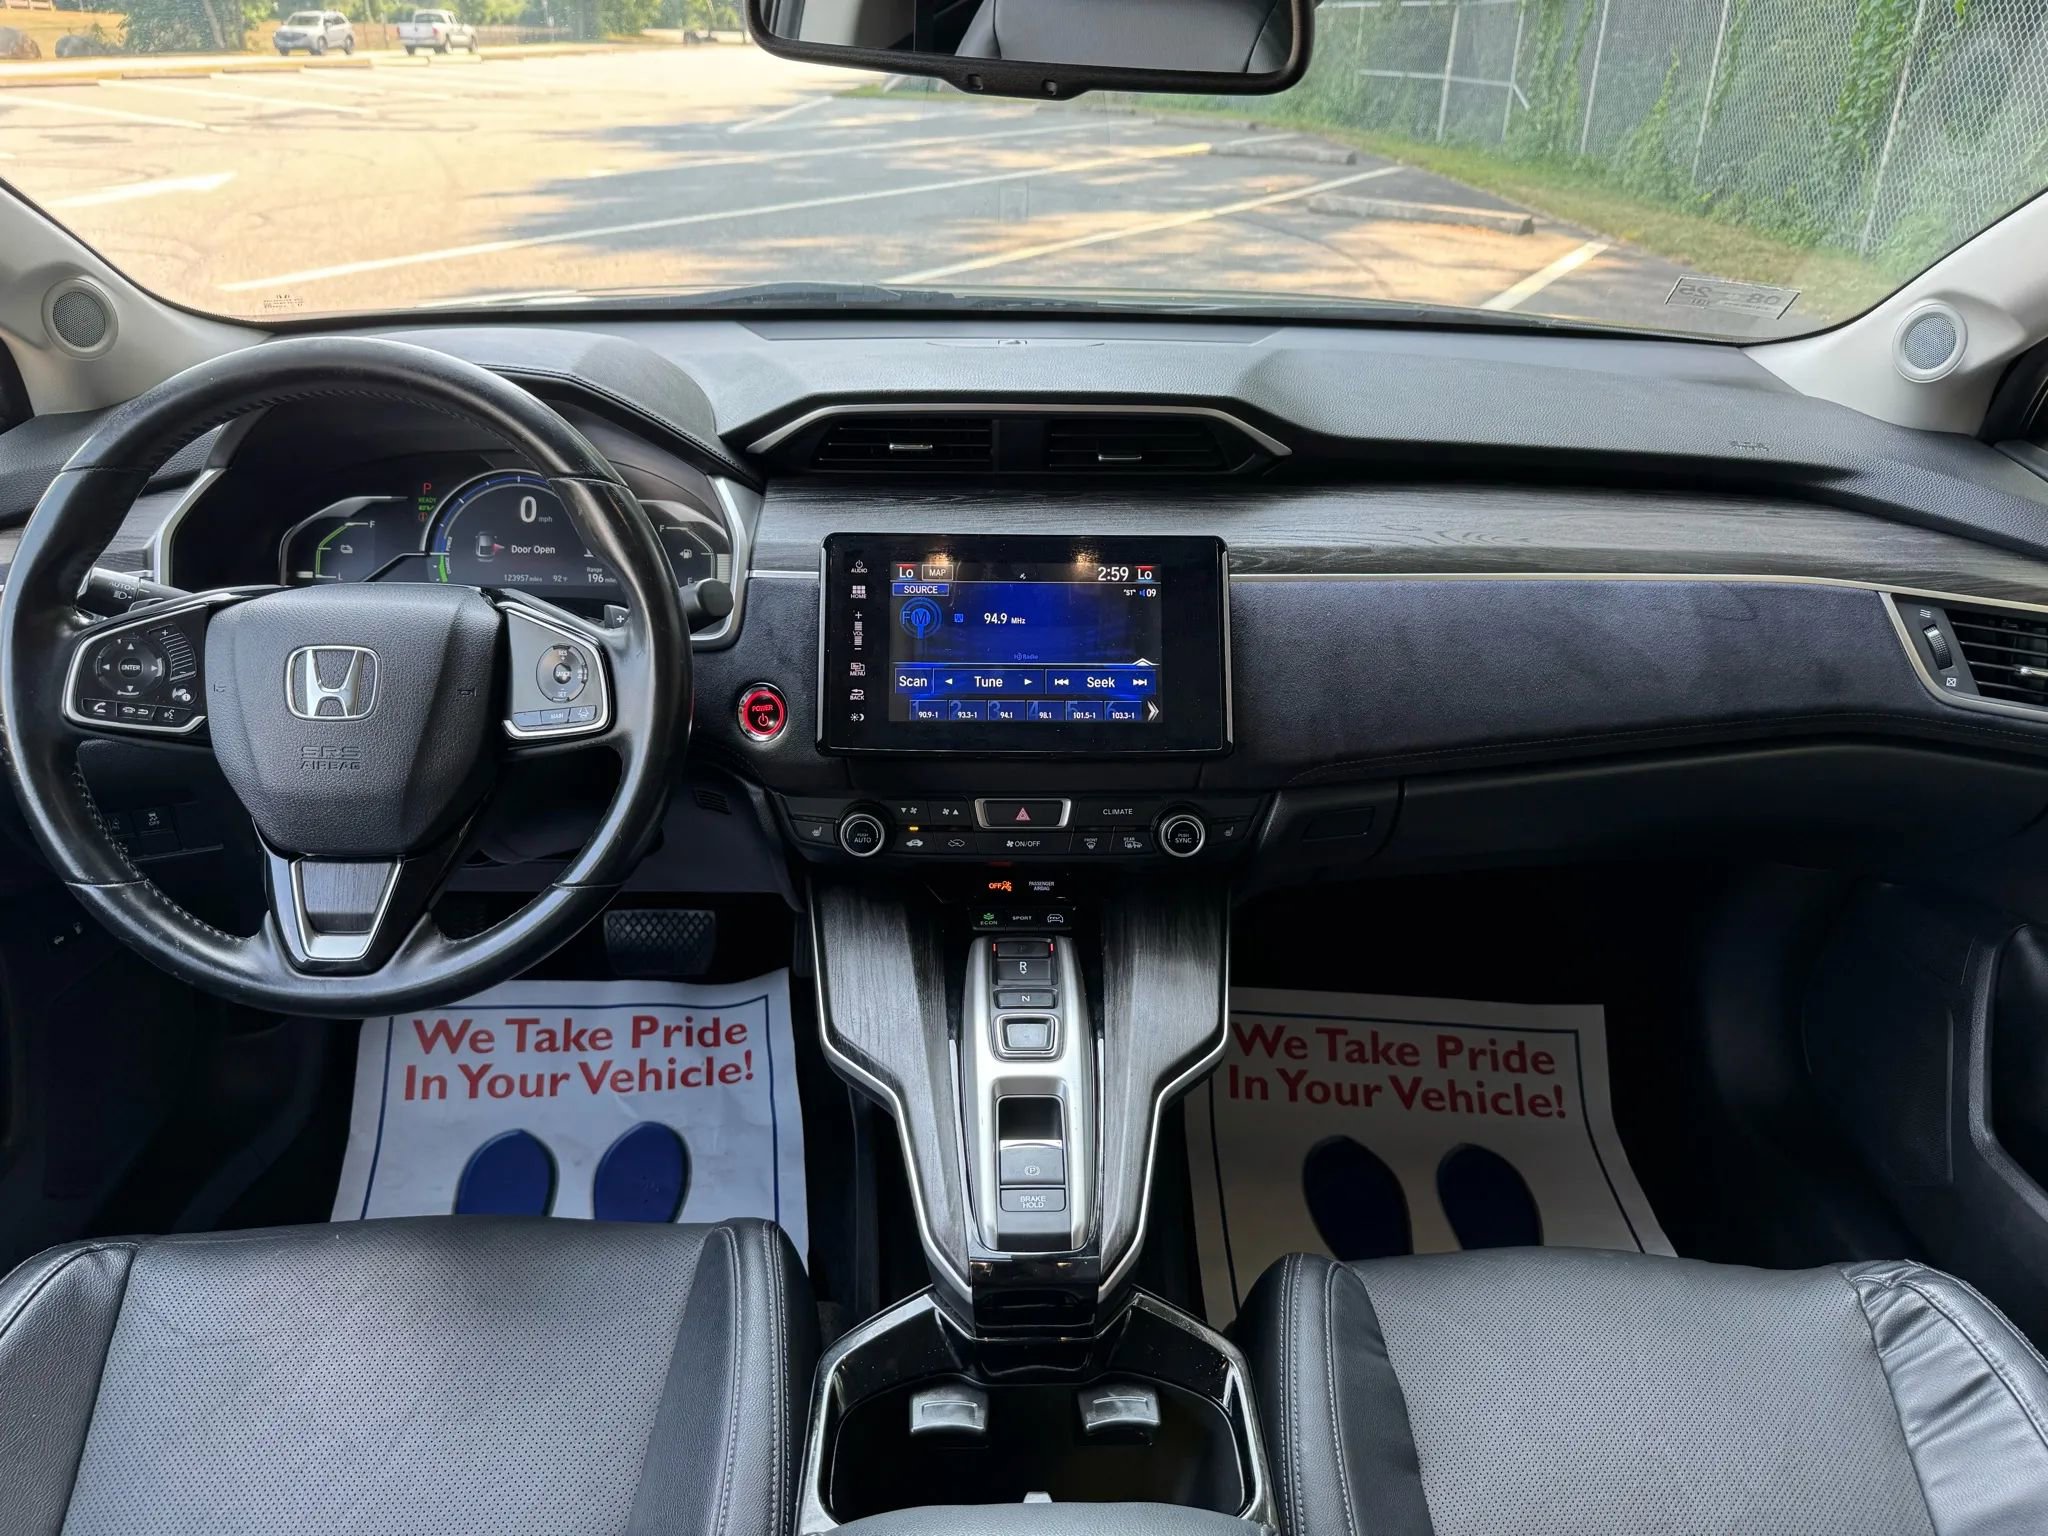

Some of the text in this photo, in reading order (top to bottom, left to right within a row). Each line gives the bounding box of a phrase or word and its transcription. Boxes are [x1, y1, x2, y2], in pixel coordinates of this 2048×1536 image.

[423, 482, 432, 495] P
[520, 495, 538, 523] 0
[369, 520, 375, 528] F
[659, 525, 665, 533] F
[511, 544, 556, 556] Door Open
[586, 566, 603, 574] Range
[899, 567, 914, 578] Lo
[929, 569, 947, 577] MAP
[1098, 566, 1129, 581] 2:59
[1137, 569, 1153, 580] Lo
[337, 572, 343, 581] L
[503, 574, 529, 582] 123957
[587, 573, 604, 583] 196
[903, 585, 938, 594] SOURCE
[1146, 588, 1157, 597] 09
[983, 613, 1007, 624] 94.9
[898, 675, 928, 688] Scan
[974, 676, 1003, 688] Tune
[1086, 676, 1116, 688] Seek
[751, 704, 774, 712] POWER
[918, 711, 939, 719] 90.9-1
[957, 711, 978, 719] 93.3-1
[999, 711, 1013, 719] 94.1
[300, 745, 362, 759] SRS
[1014, 840, 1041, 848] ON/OFF
[988, 881, 1003, 890] OFF
[1019, 961, 1028, 972] R
[413, 1015, 748, 1054] We Take Pride
[1229, 1022, 1556, 1076] We Take Pride
[404, 1050, 754, 1101] In Your Vehicle!
[1228, 1064, 1567, 1119] In Your Vehicle!
